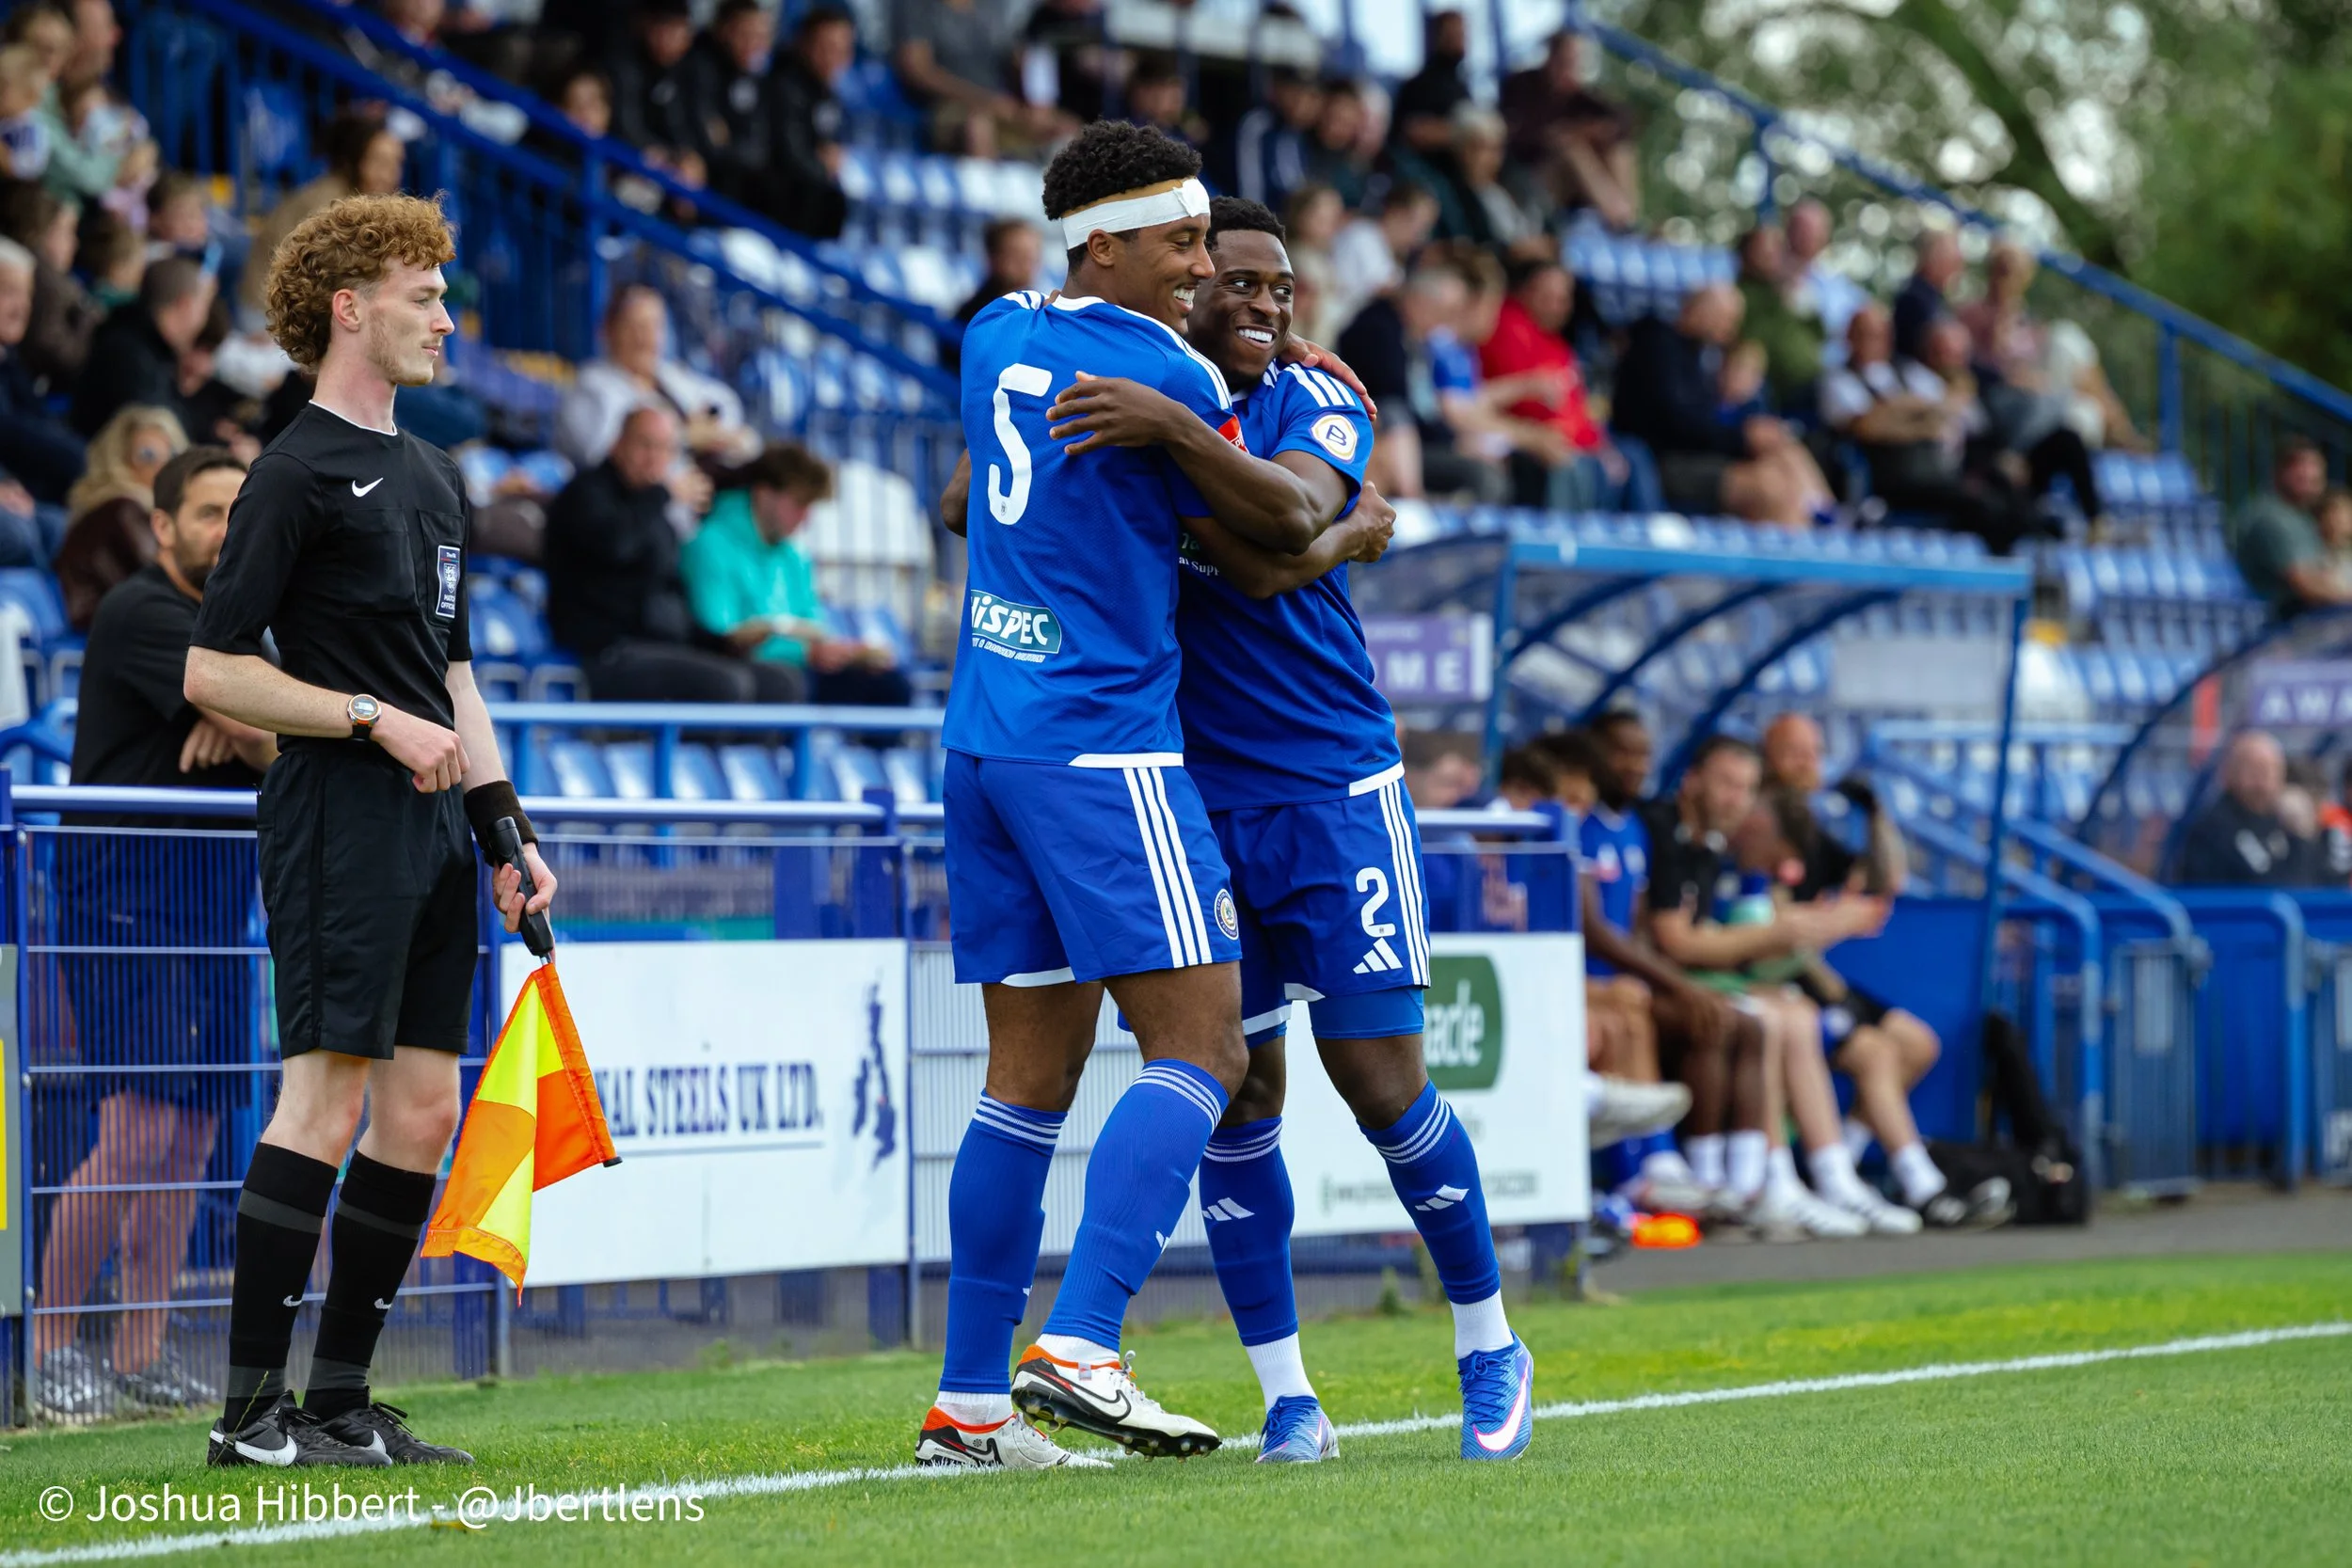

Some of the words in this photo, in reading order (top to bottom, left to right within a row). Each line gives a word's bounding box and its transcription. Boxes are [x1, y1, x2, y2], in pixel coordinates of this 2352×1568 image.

[988, 363, 1053, 525] 5
[1356, 867, 1396, 938] 2
[647, 1066, 728, 1135] STEELS
[737, 1064, 770, 1132] UK
[778, 1062, 823, 1130] LTD.
